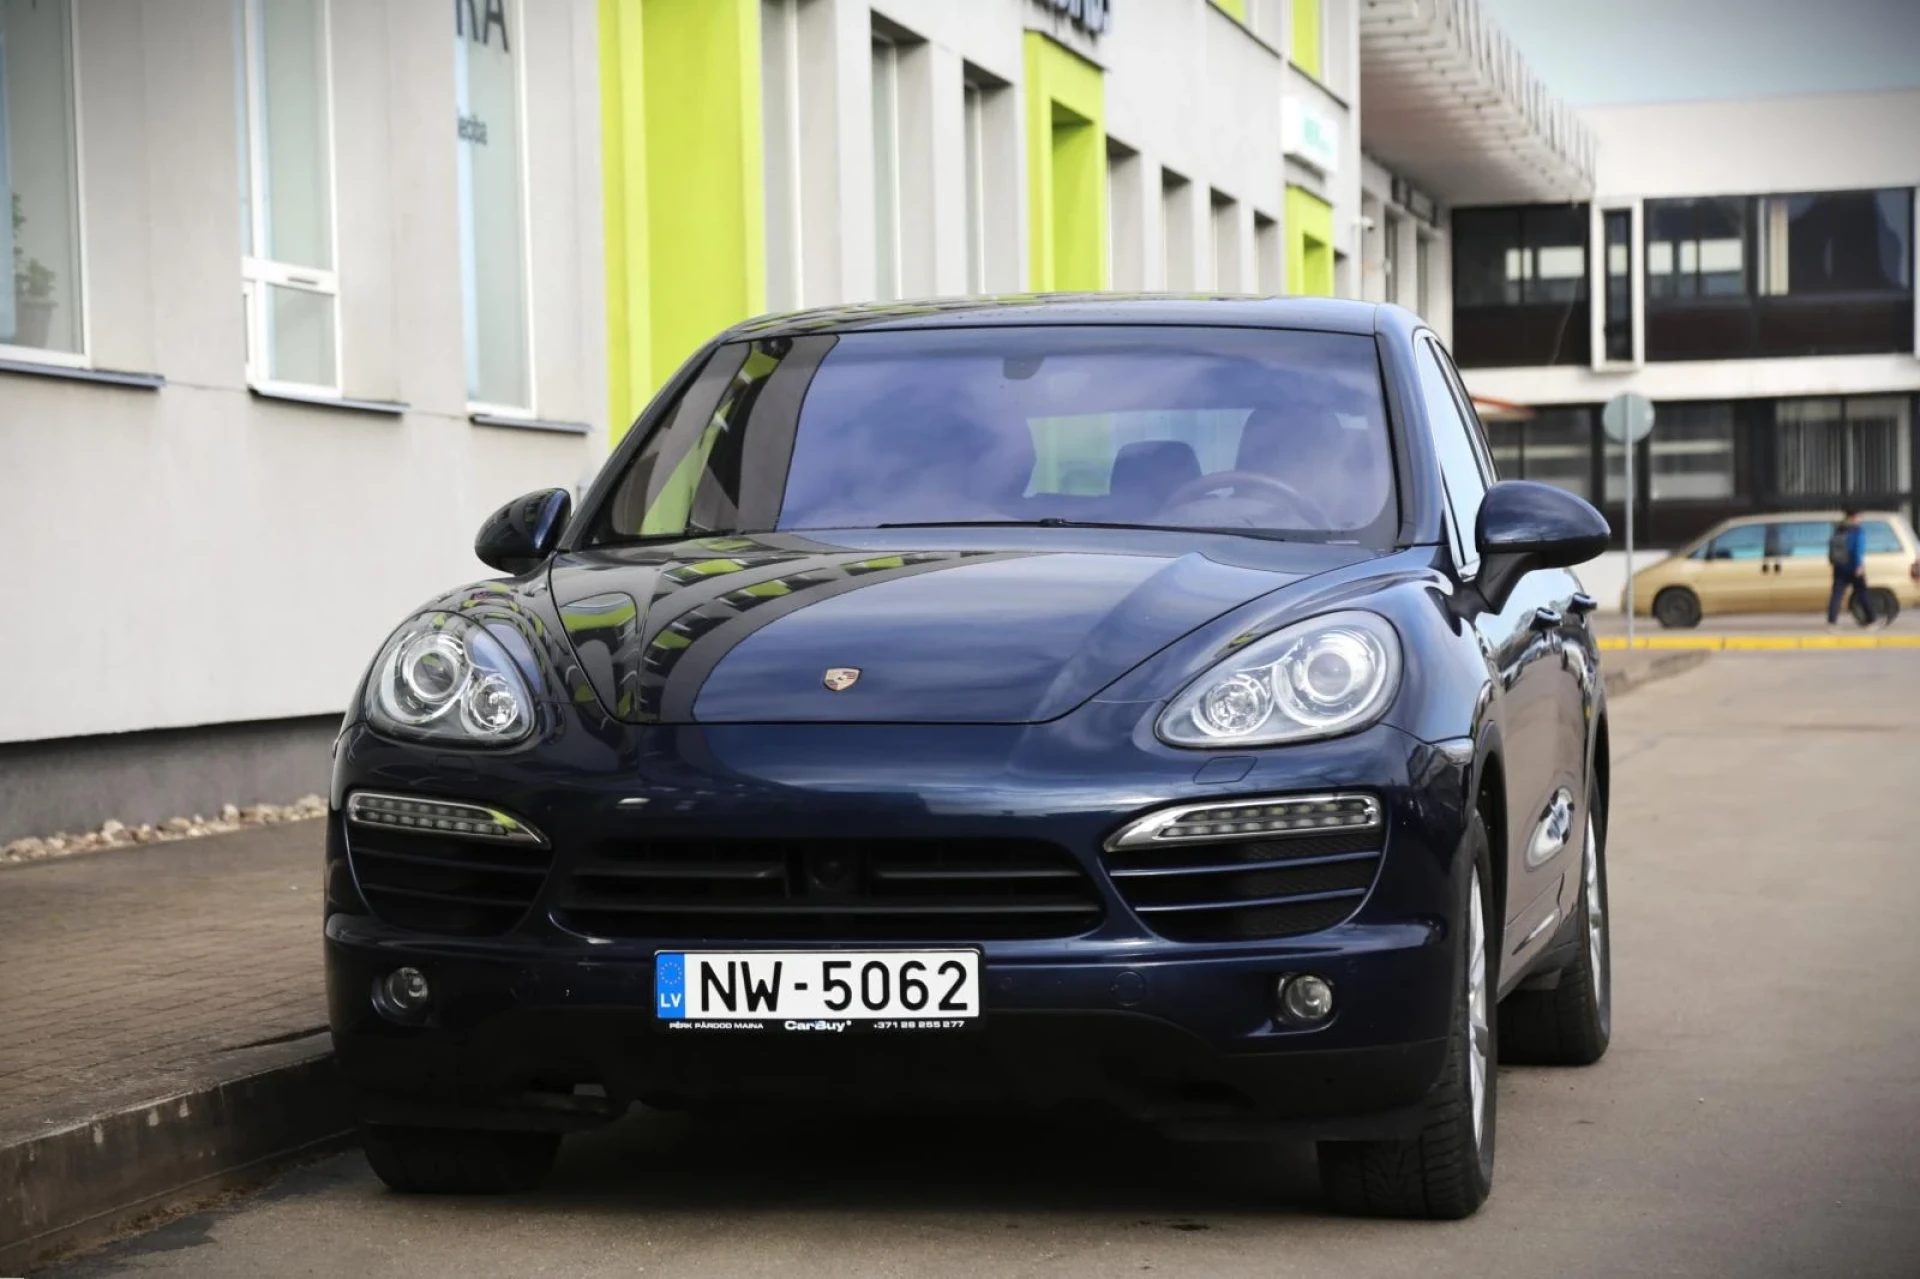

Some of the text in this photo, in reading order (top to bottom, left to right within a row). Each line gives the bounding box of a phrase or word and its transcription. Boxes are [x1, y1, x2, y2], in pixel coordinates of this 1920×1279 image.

[700, 960, 968, 1012] NW-5062
[660, 993, 682, 1008] LV
[873, 1021, 898, 1029] +371
